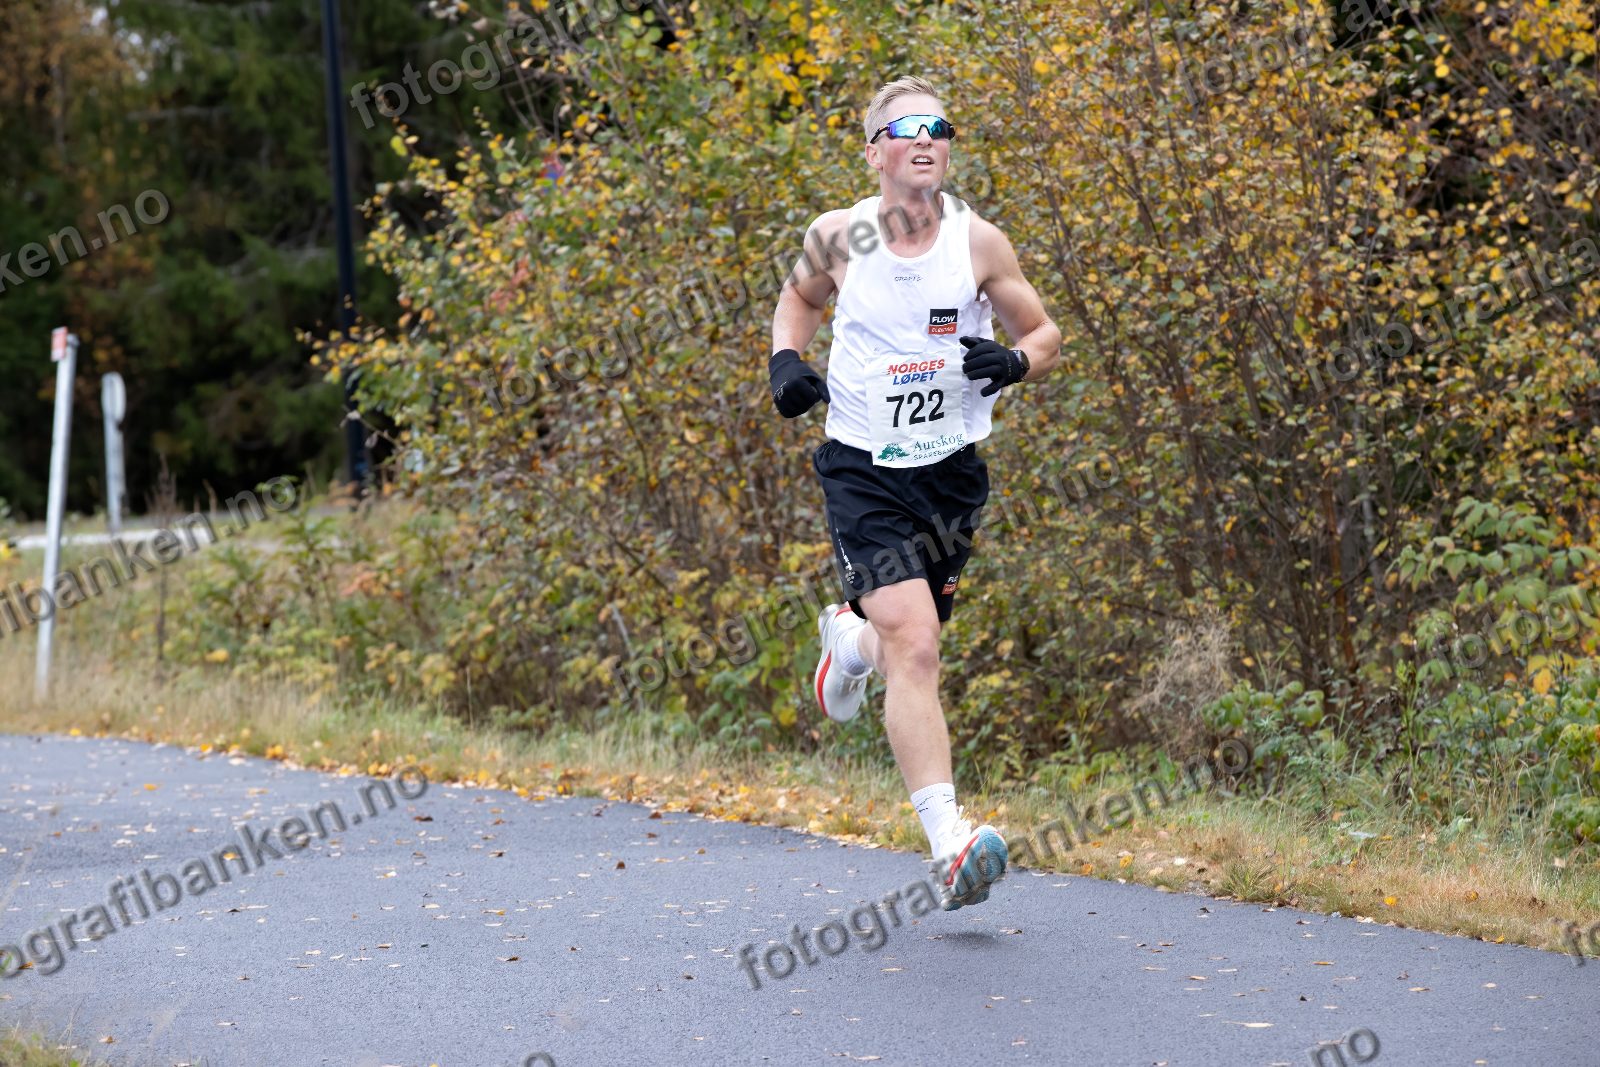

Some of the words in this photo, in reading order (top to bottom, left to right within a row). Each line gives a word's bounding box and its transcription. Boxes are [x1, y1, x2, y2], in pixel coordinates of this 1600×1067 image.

[932, 315, 955, 323] FLOW
[887, 359, 945, 374] NORGES
[893, 371, 937, 385] LØPET
[886, 389, 945, 428] 722
[913, 433, 965, 452] Aurskog
